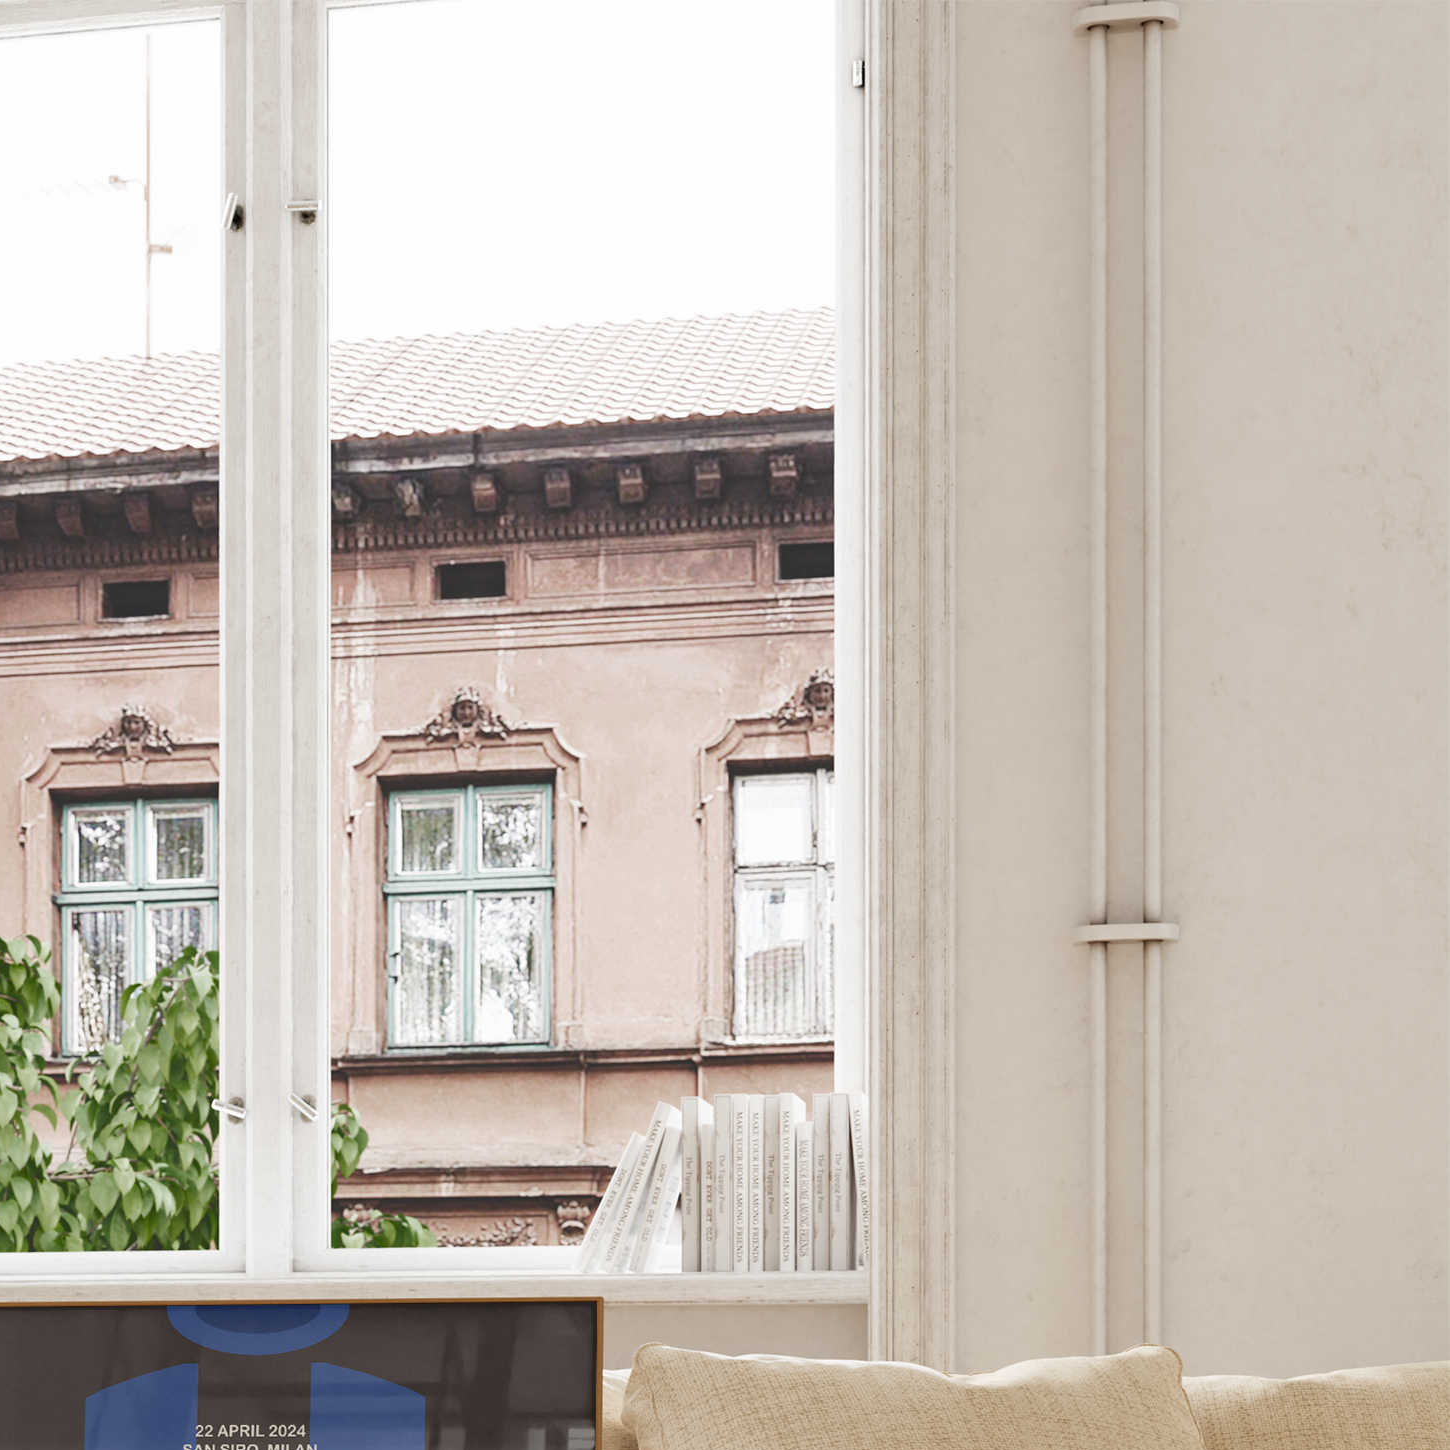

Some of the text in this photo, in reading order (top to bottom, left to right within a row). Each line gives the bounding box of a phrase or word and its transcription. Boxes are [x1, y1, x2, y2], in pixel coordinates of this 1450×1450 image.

[853, 1109, 861, 1134] MAKE
[855, 1136, 864, 1160] YOUR
[685, 1171, 693, 1197] Tipping
[816, 1169, 824, 1195] Tipping
[858, 1161, 866, 1188] HOME
[605, 1191, 617, 1208] EVER
[606, 1119, 662, 1262] MAKE YOUR HOME AMONG FRIENDS
[651, 1186, 661, 1206] EVER
[799, 1139, 809, 1258] MAKE YOUR HOME AMONG FRIENDS
[646, 1209, 655, 1224] GET
[860, 1190, 869, 1223] AMONG
[597, 1212, 607, 1226] GET
[590, 1228, 599, 1243] OLD
[641, 1227, 650, 1242] OLD
[194, 1424, 307, 1438] 22 APRIL 2024
